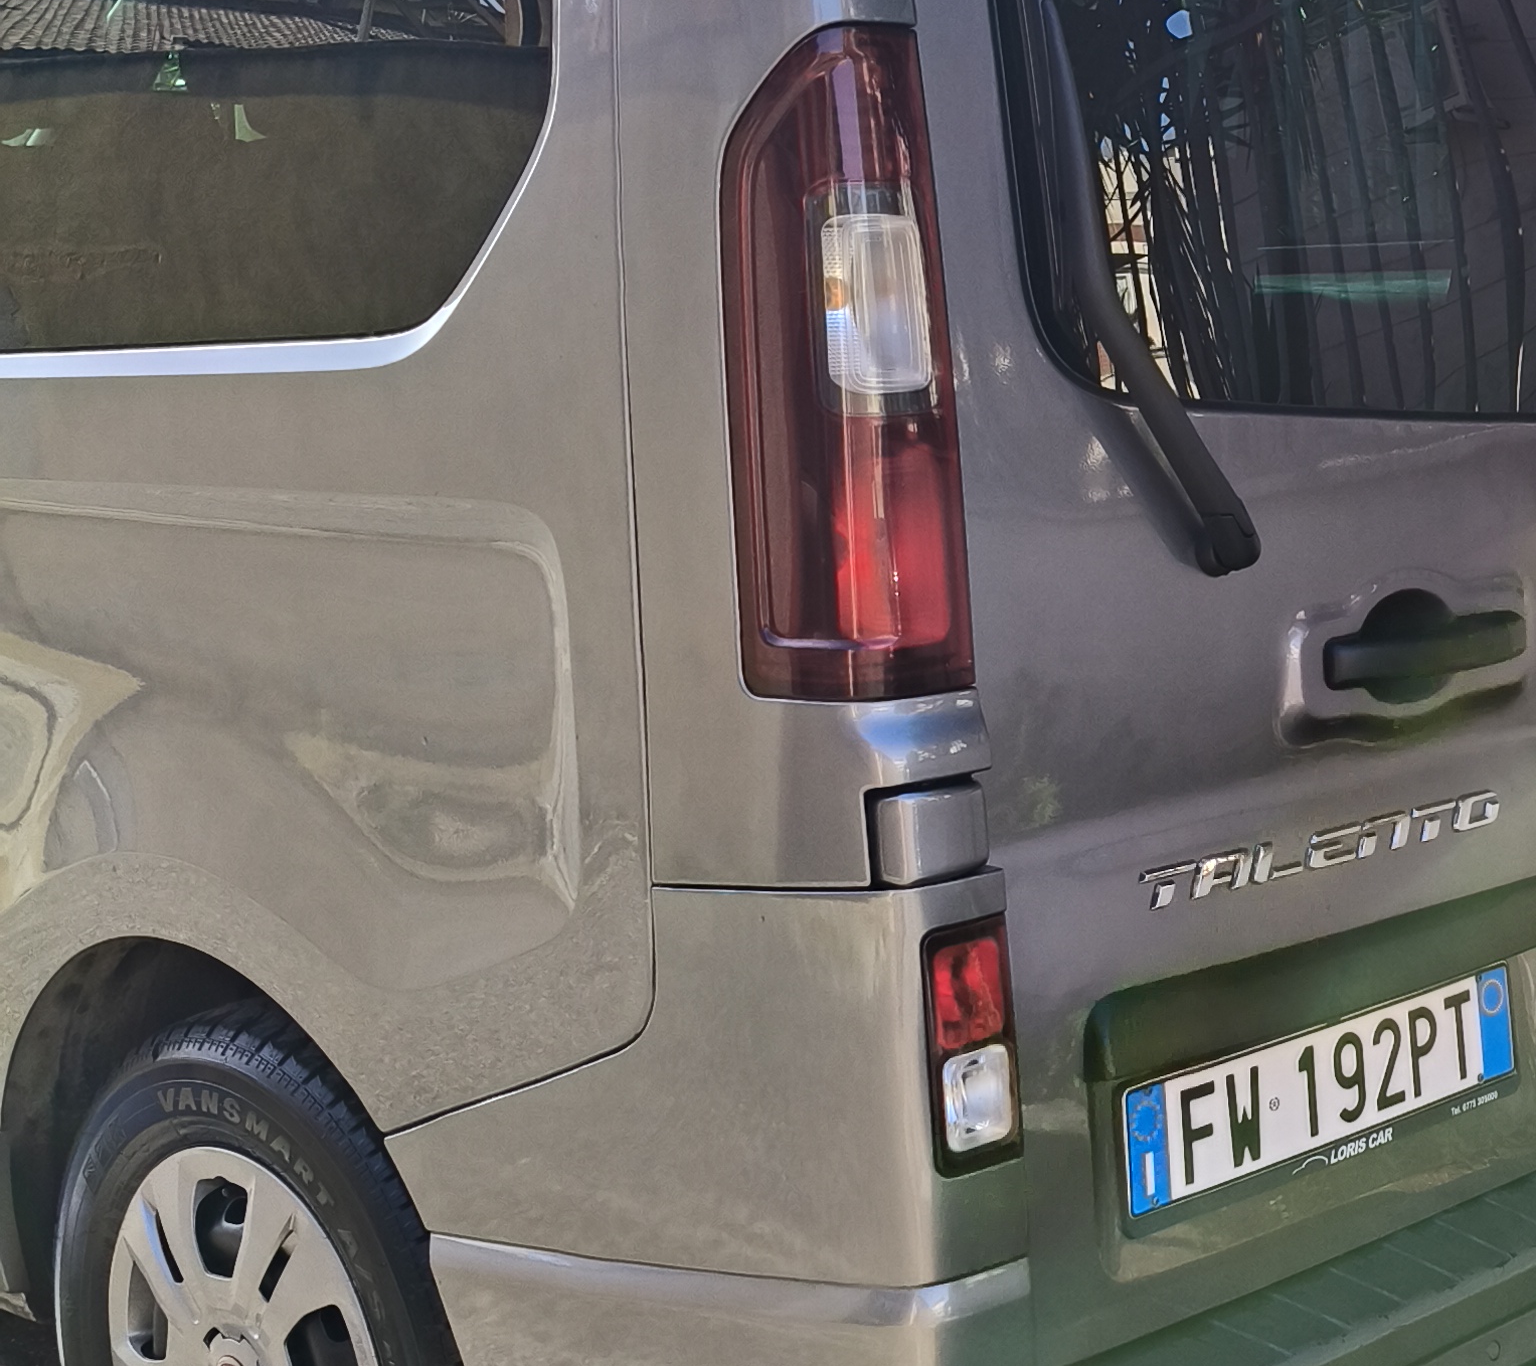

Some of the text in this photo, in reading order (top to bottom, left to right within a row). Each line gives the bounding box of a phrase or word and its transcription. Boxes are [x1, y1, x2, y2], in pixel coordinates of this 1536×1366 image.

[1138, 788, 1501, 911] TALENTO
[157, 1087, 337, 1210] VANSMART
[1179, 989, 1472, 1187] FW 192PT
[1330, 1127, 1394, 1165] LORIS CAR
